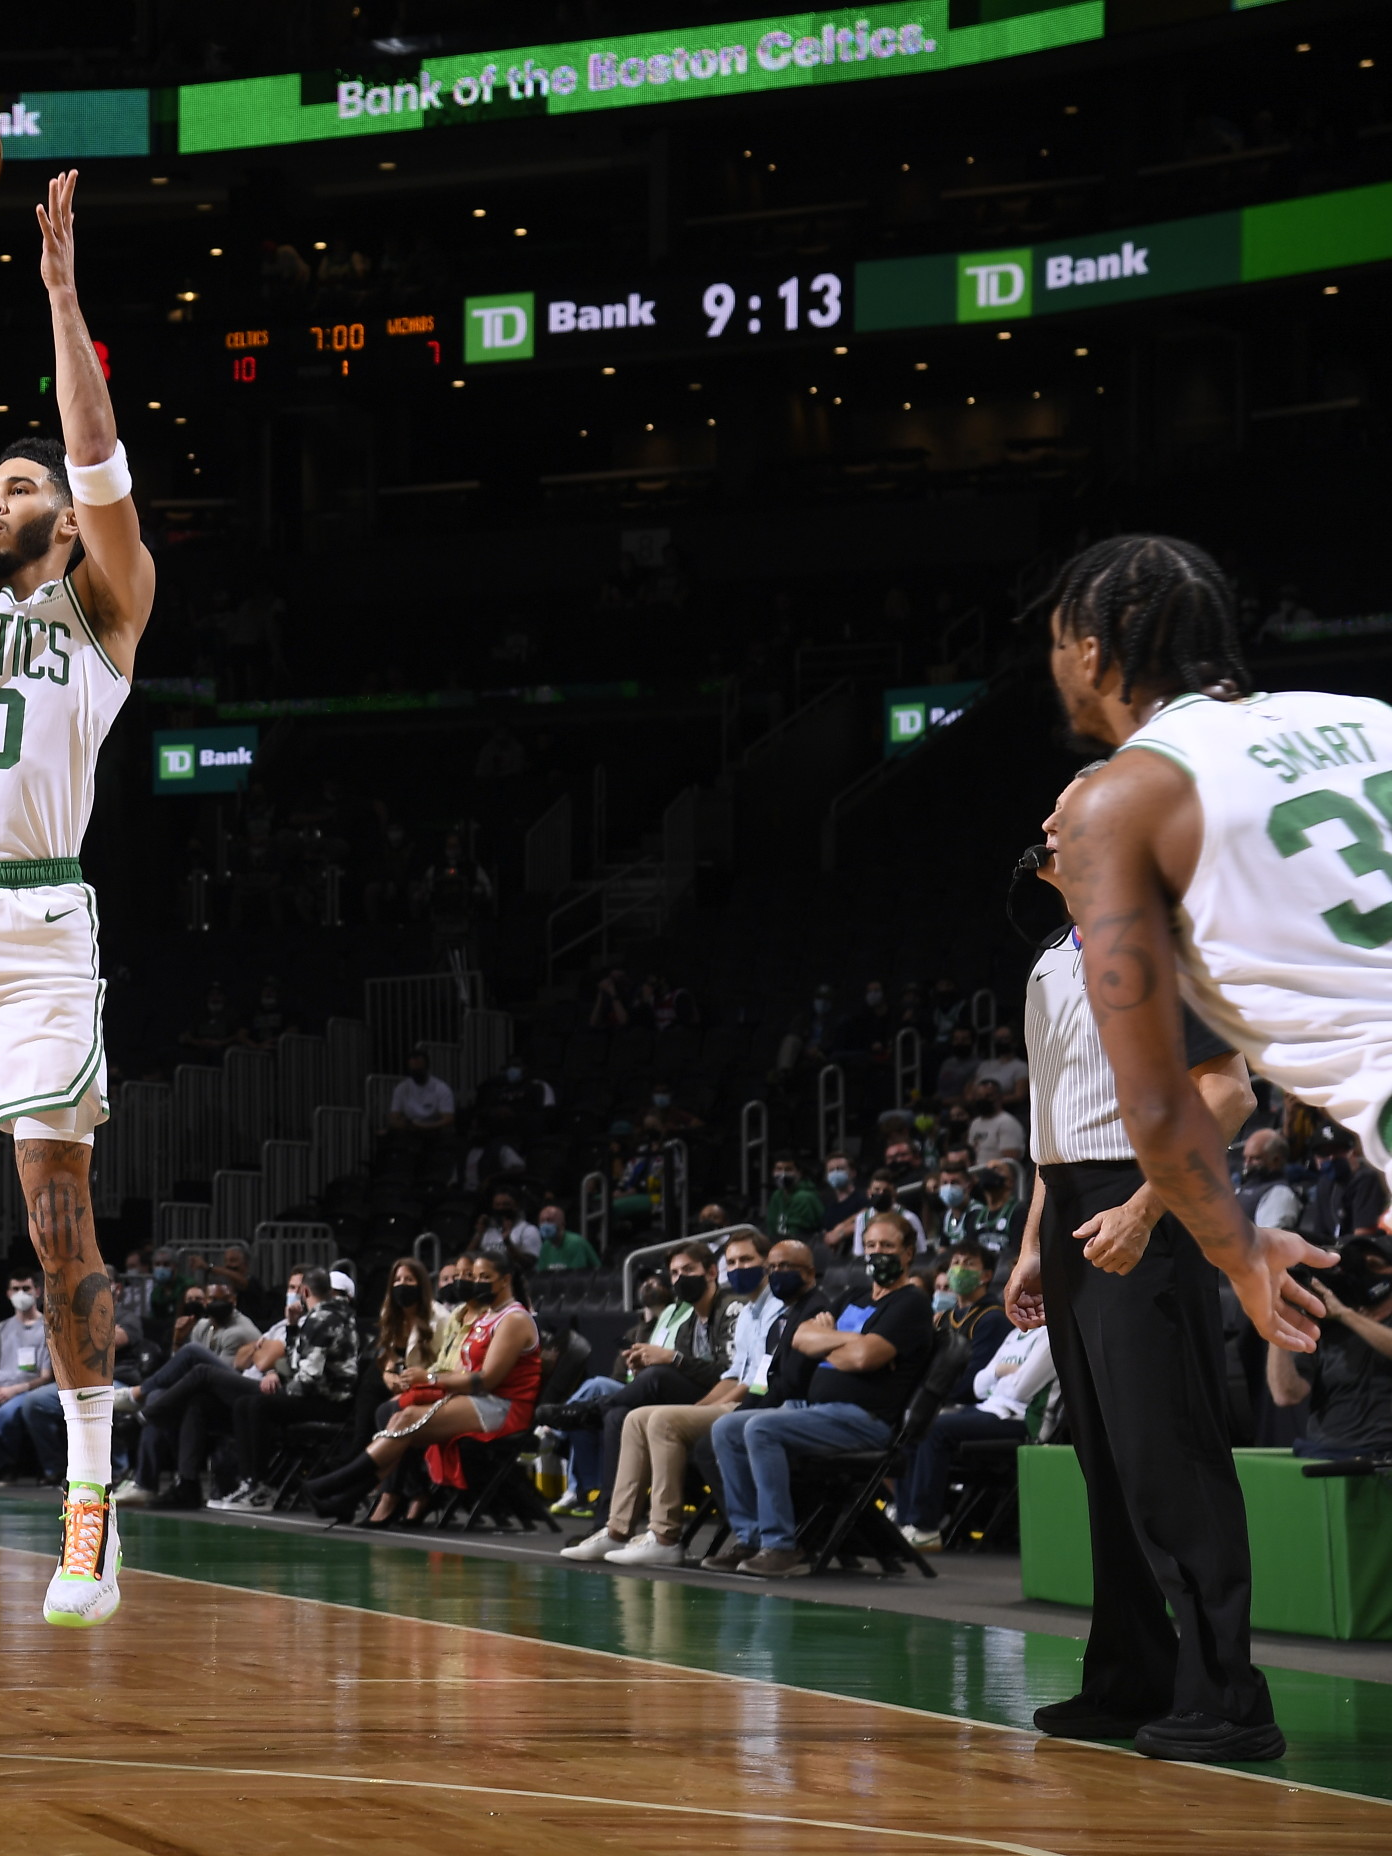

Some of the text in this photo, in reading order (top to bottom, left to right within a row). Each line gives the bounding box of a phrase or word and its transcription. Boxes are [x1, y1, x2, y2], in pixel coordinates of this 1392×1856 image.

[337, 19, 937, 119] Bank of the Boston Celtics.
[703, 273, 843, 336] 9:13
[965, 242, 1149, 307] TD Bank
[310, 323, 365, 352] 7:00
[471, 293, 656, 348] TD Bank
[233, 356, 256, 382] 10
[427, 340, 441, 365] 7
[162, 747, 252, 772] TD Bank
[1247, 722, 1376, 784] SMART
[1266, 769, 1392, 950] 3
